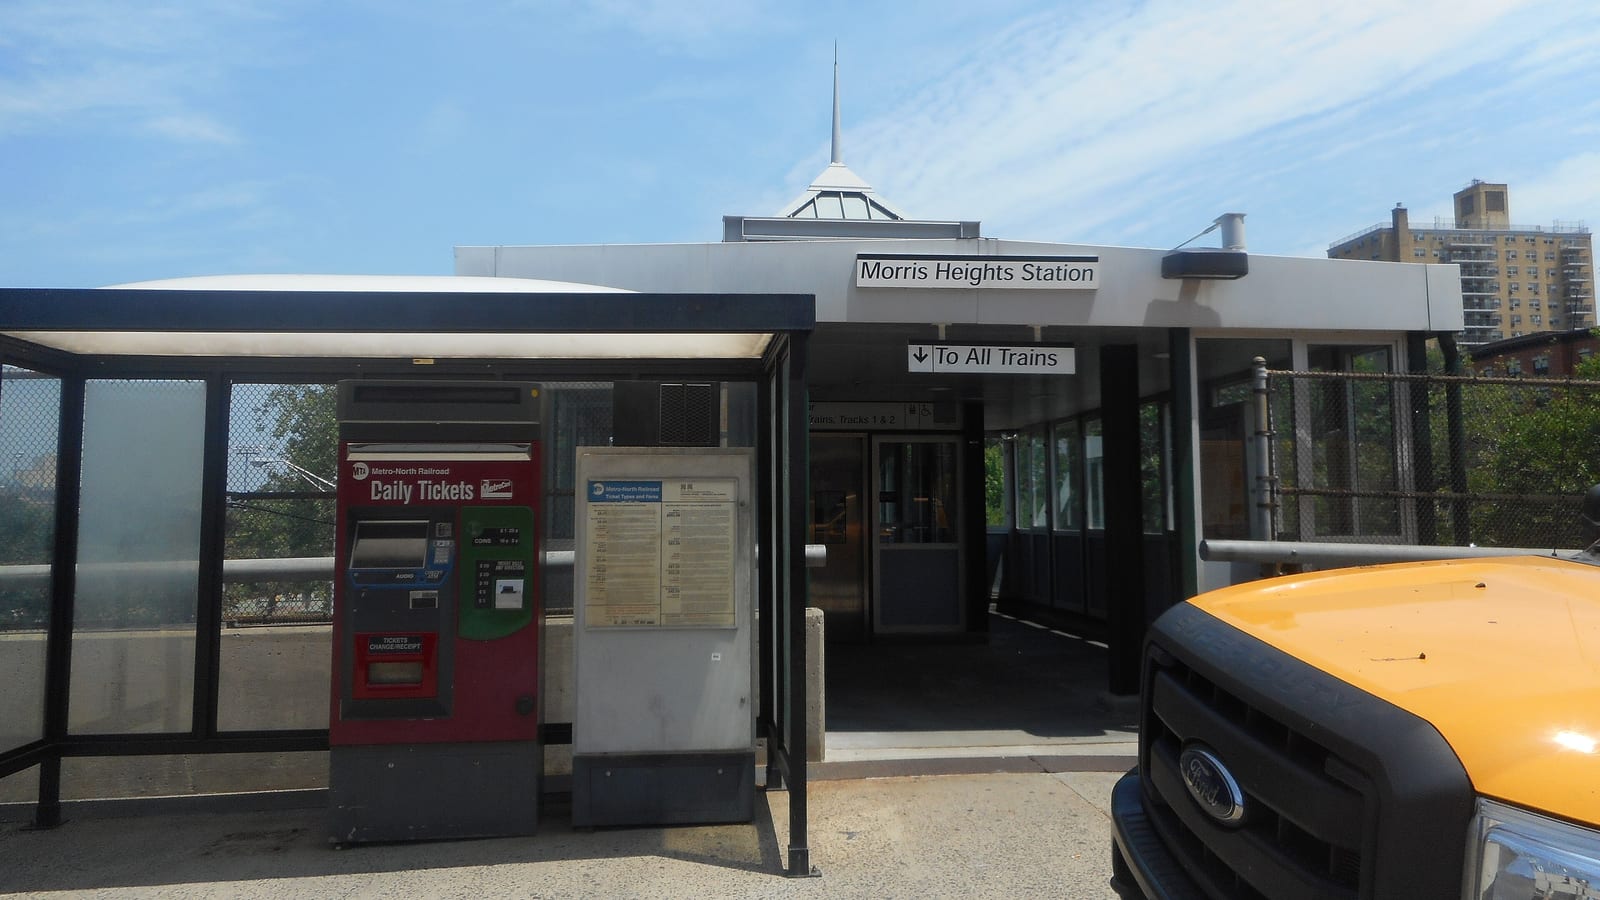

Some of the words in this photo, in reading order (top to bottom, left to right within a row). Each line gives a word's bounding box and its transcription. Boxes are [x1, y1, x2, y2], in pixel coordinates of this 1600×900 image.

[860, 262, 928, 280] Morris
[935, 262, 1014, 286] Heights
[1021, 263, 1094, 282] Station
[935, 347, 959, 365] To
[965, 347, 991, 366] All
[998, 348, 1058, 366] Trains
[839, 415, 869, 424] Tracks
[872, 415, 877, 424] 1
[879, 415, 888, 424] &
[888, 415, 896, 424] 2
[371, 467, 417, 476] Metro-North
[418, 467, 450, 475] Railroad
[417, 480, 474, 500] Tickets
